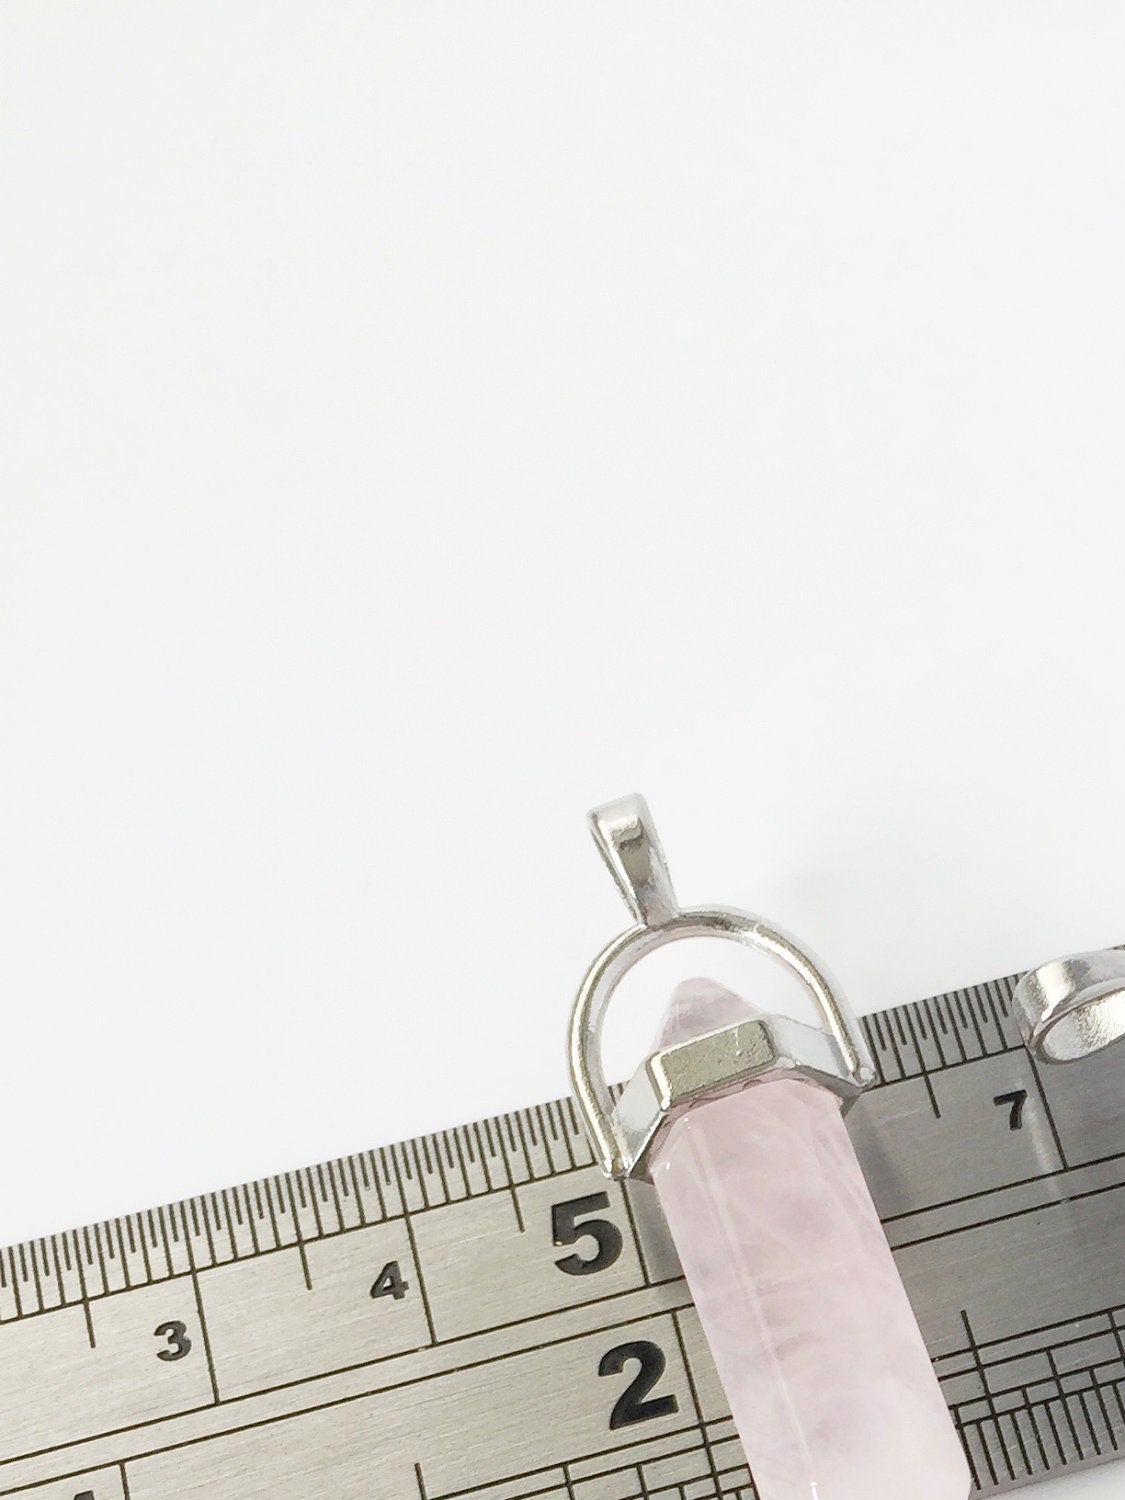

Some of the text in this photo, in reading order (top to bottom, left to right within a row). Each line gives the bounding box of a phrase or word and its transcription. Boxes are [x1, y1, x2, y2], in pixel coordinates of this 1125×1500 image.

[153, 1321, 192, 1361] 3
[370, 1260, 409, 1299] 4
[551, 1192, 623, 1275] 5
[993, 1089, 1028, 1130] 7
[598, 1340, 679, 1430] 2
